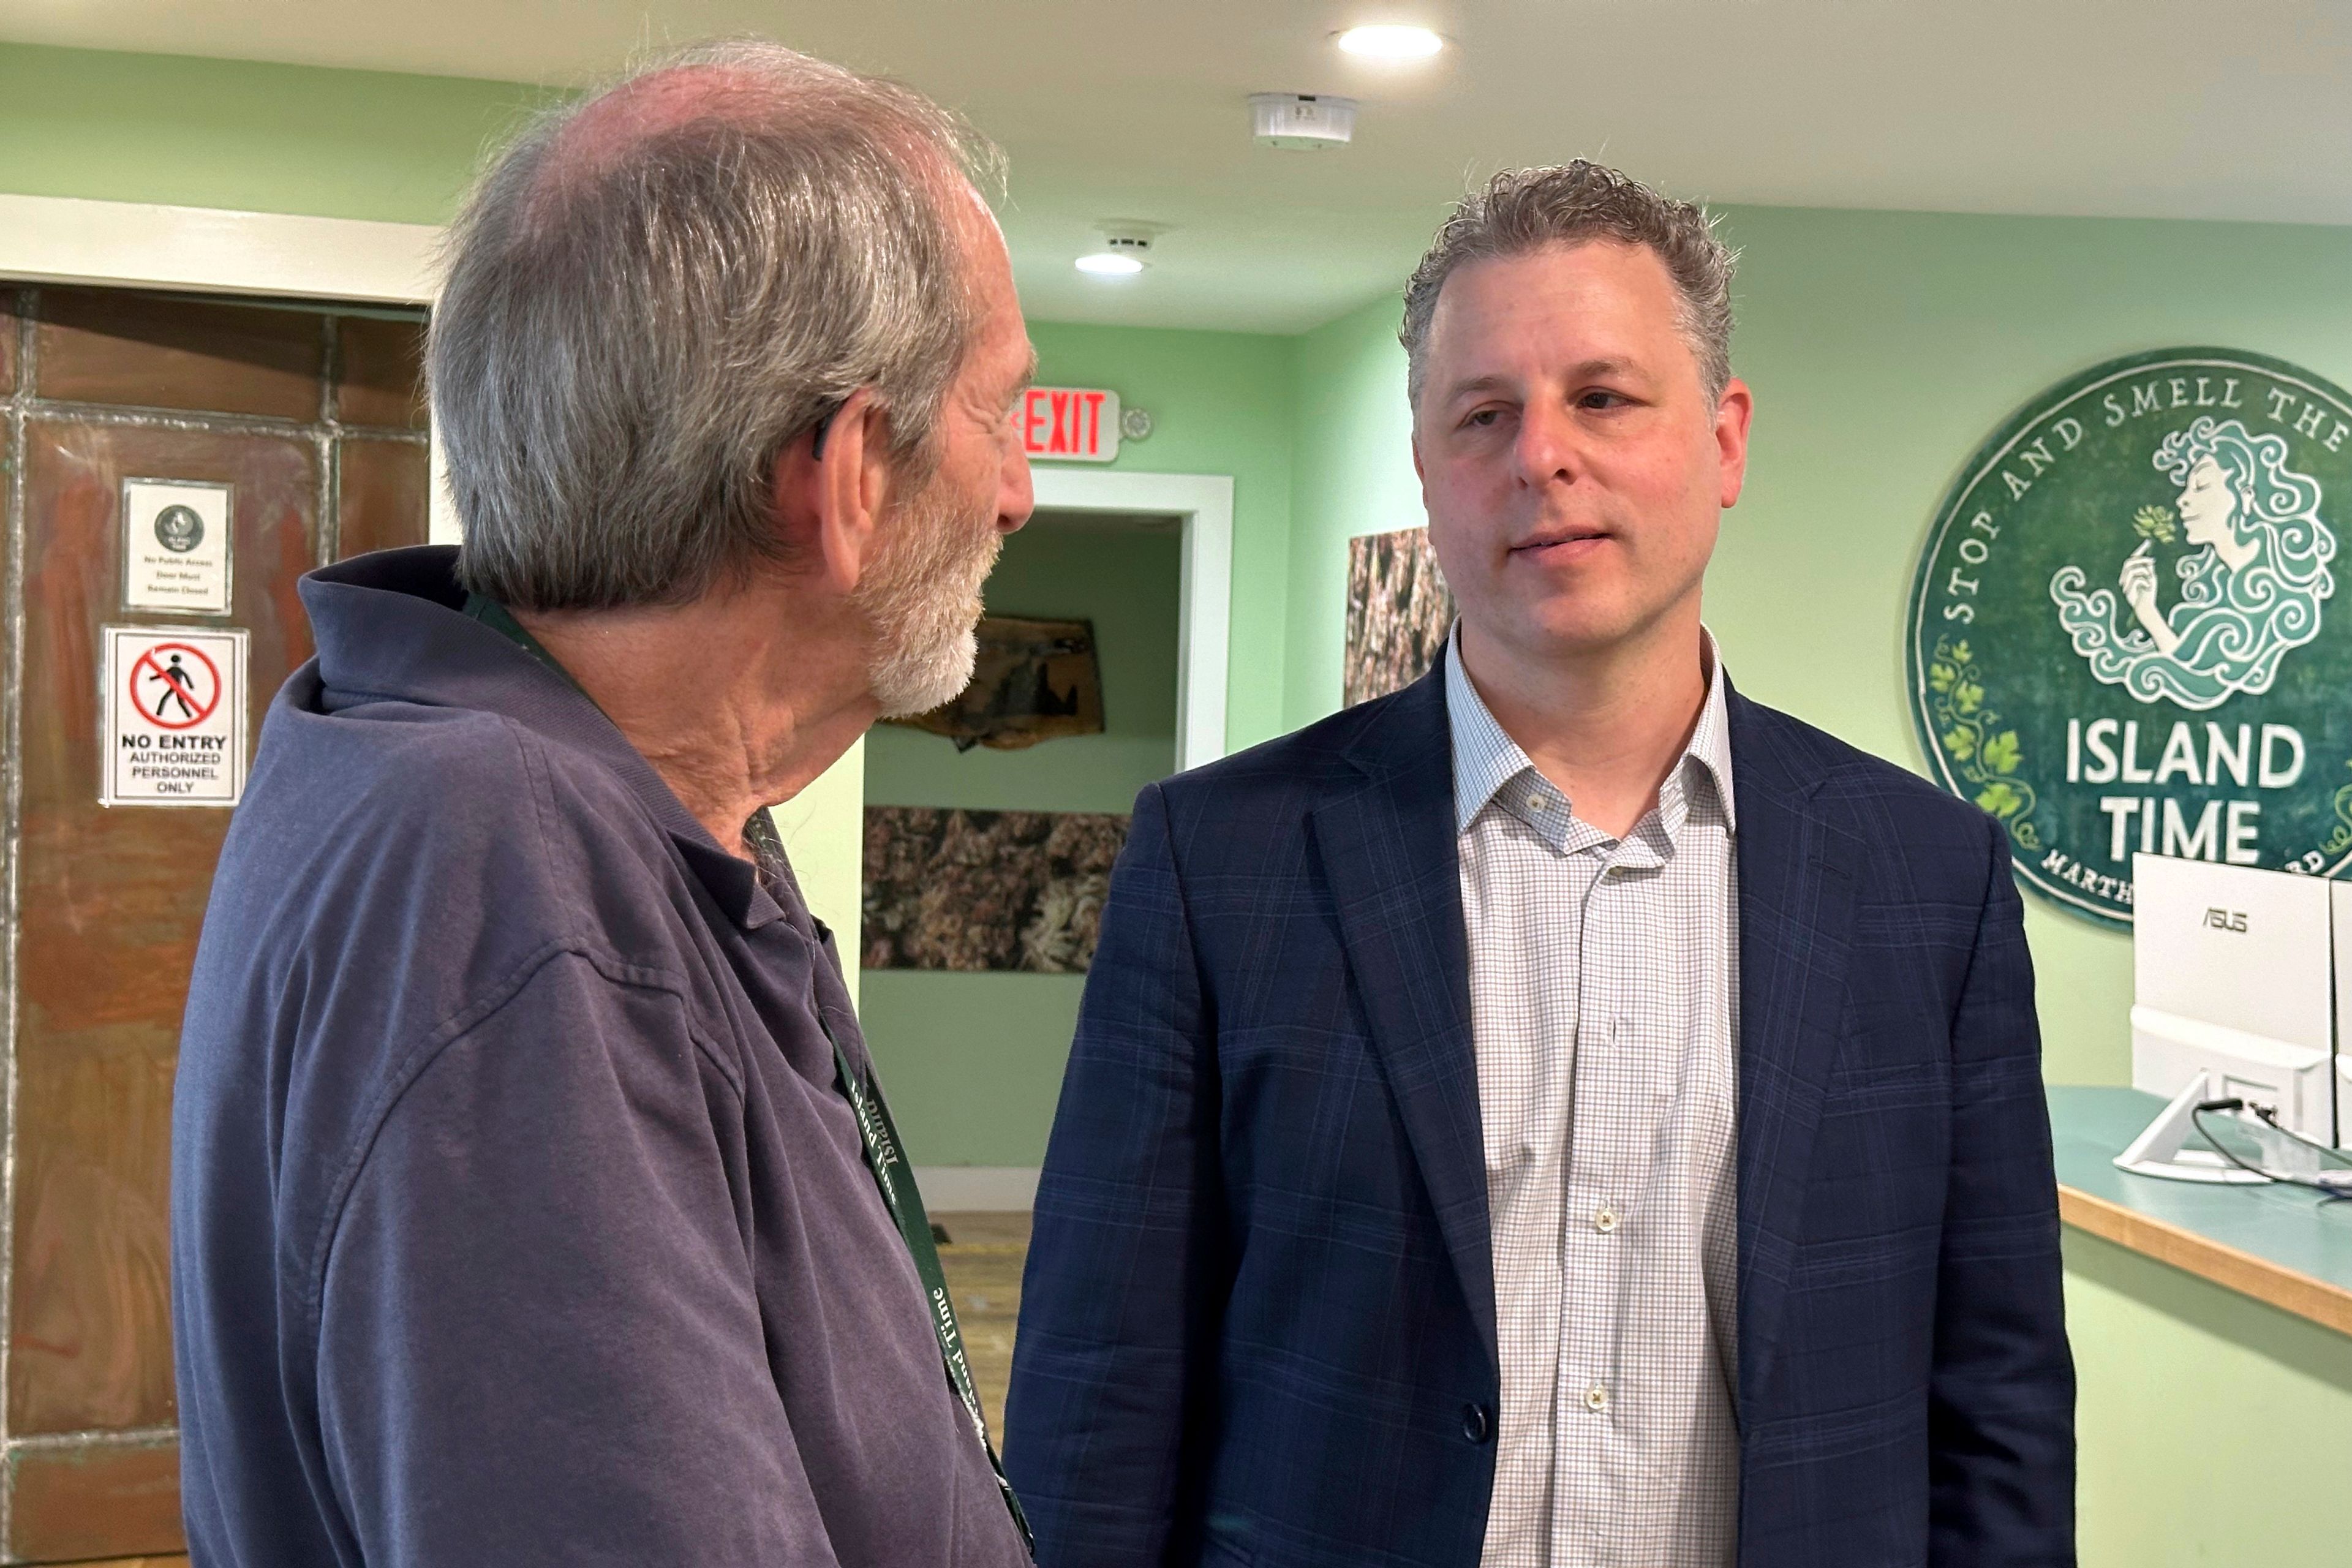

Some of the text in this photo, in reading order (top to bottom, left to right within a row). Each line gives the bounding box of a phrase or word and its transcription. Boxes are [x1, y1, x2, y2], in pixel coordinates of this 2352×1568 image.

[1025, 388, 1106, 455] EXIT
[1943, 377, 2350, 625] STOP AND SMELL THE
[144, 555, 213, 567] No Public Access
[181, 586, 209, 595] Closed
[122, 734, 227, 750] NO ENTRY
[130, 751, 221, 764] AUTHORIZED
[2065, 718, 2306, 789] ISLAND
[132, 766, 219, 780] PERSONNEL
[156, 781, 194, 794] ONLY
[2100, 796, 2261, 864] TIME
[2040, 848, 2133, 905] MARTH
[2203, 908, 2247, 933] ASUS
[851, 1079, 896, 1205] Island Time
[933, 1287, 957, 1348] Time
